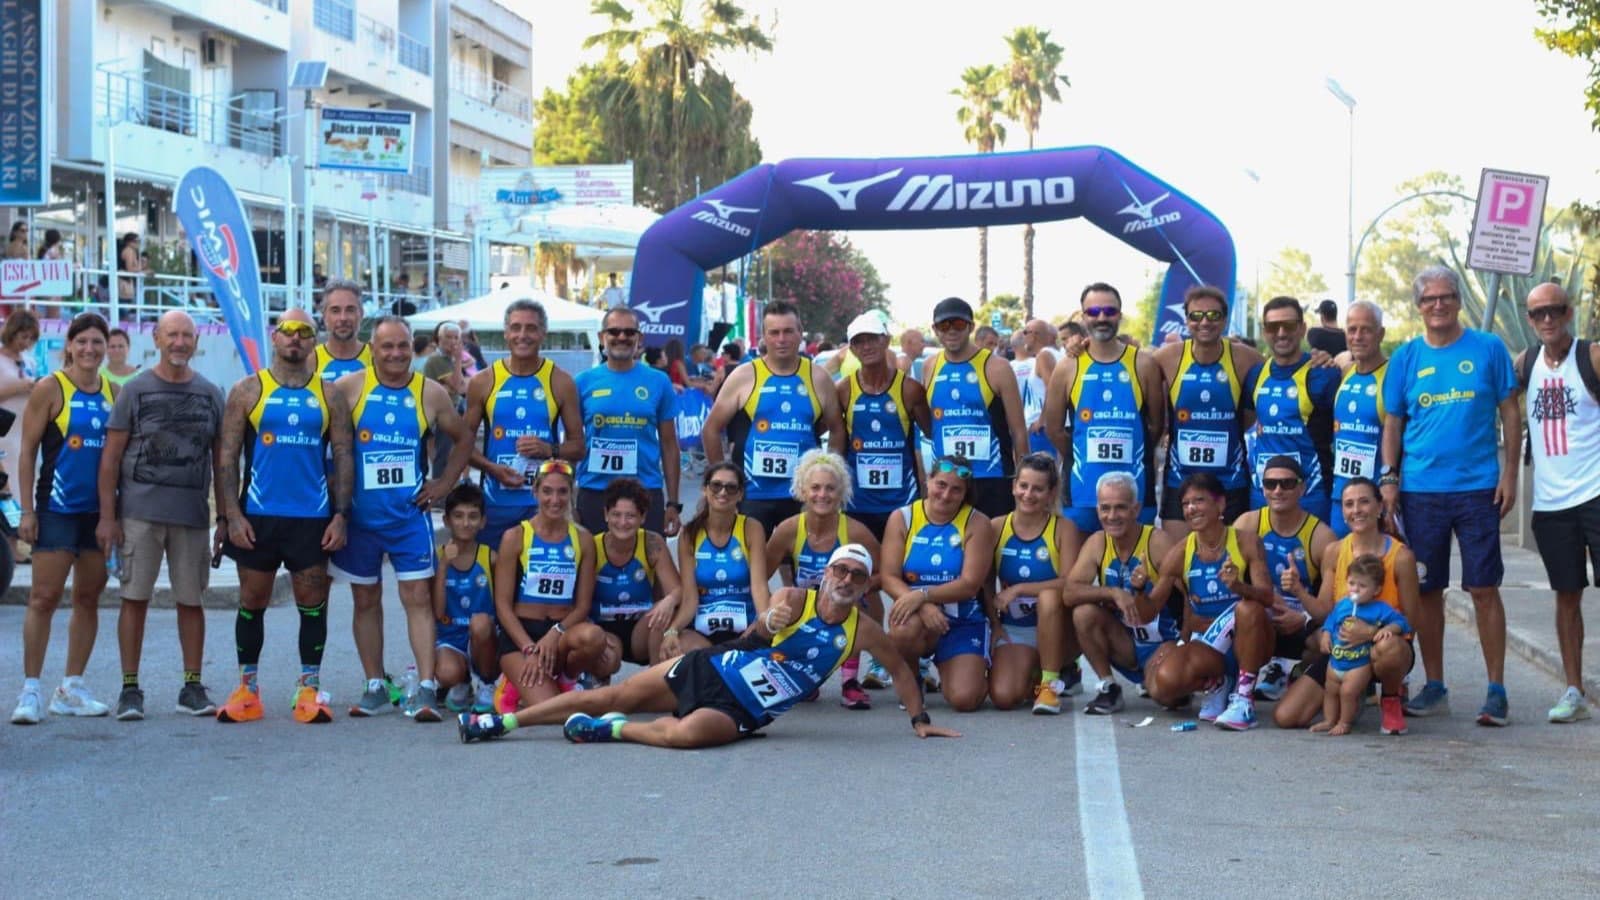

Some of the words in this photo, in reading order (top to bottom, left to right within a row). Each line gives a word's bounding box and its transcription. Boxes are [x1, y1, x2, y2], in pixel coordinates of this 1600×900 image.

[2, 1, 17, 74] LAGHI
[2, 82, 17, 105] DI
[21, 9, 37, 182] ASSOCIAZIONE
[331, 122, 354, 134] Black
[357, 125, 374, 135] and
[375, 125, 401, 137] White
[2, 112, 17, 189] SIBARI
[1496, 187, 1526, 220] P
[41, 263, 70, 281] VIVA
[954, 441, 975, 457] 91
[1097, 443, 1124, 460] 95
[1189, 447, 1216, 463] 88
[601, 455, 624, 471] 70
[762, 457, 787, 474] 93
[1340, 456, 1361, 475] 96
[377, 467, 404, 485] 80
[868, 469, 890, 485] 81
[538, 578, 564, 596] 89
[751, 673, 778, 703] 72
